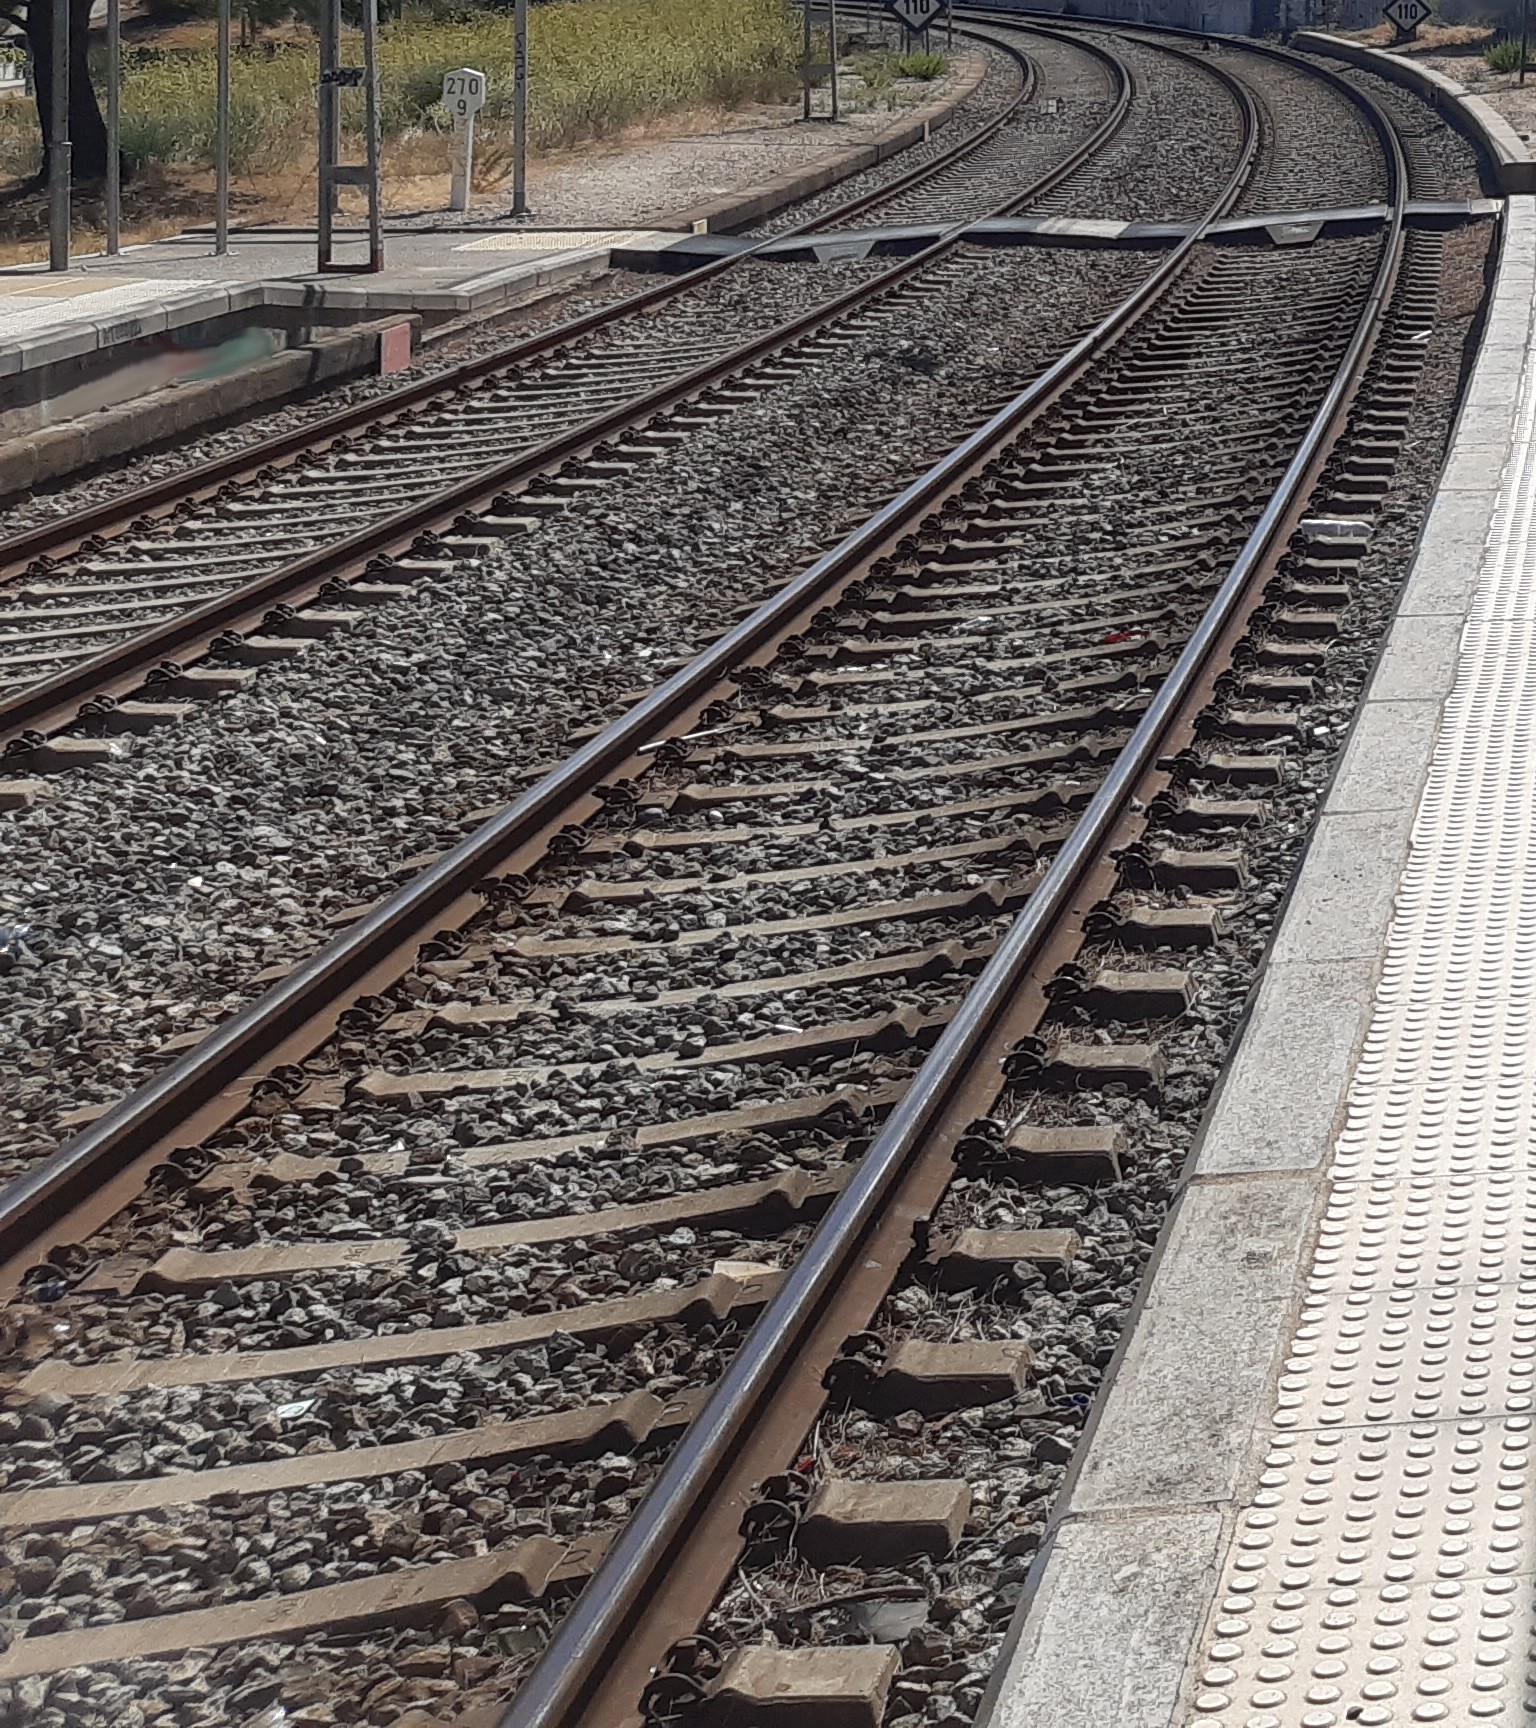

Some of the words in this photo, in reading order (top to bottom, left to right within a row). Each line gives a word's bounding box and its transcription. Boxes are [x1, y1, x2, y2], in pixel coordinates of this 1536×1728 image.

[1397, 3, 1418, 20] 110
[446, 77, 479, 95] 270
[457, 99, 467, 116] 9
